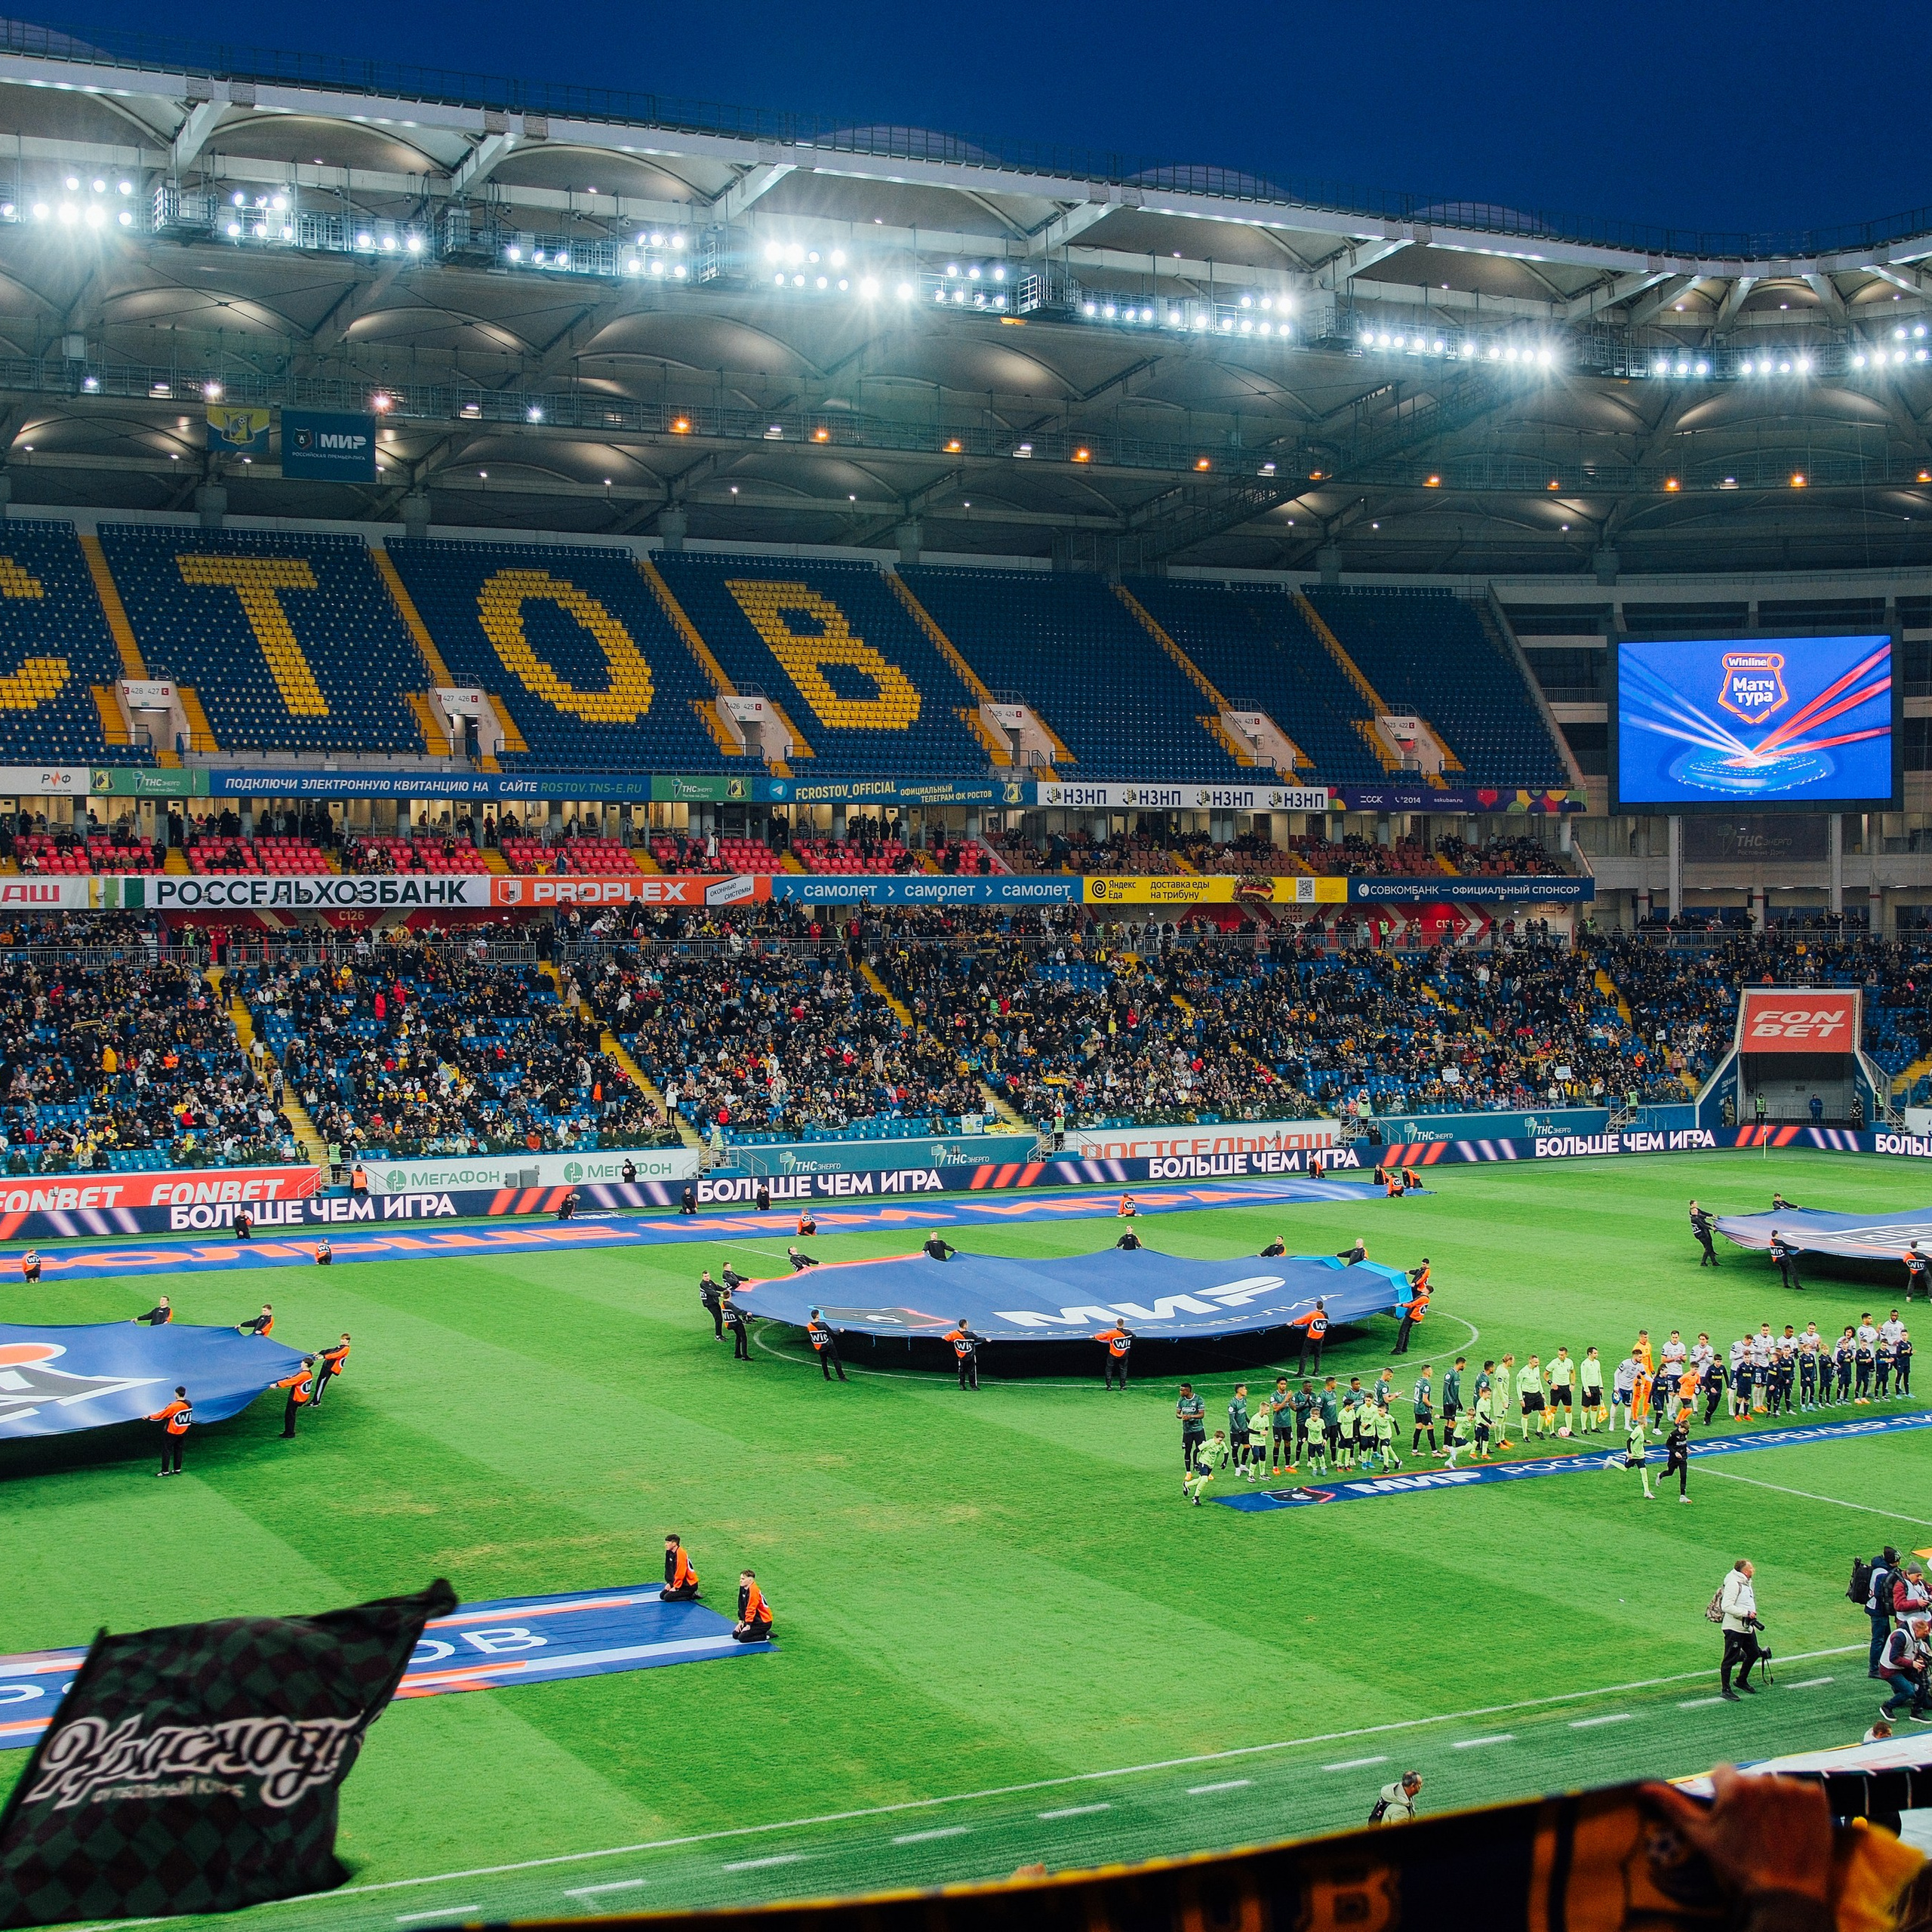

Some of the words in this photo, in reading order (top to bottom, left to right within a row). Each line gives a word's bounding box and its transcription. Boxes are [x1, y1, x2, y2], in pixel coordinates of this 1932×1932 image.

[321, 433, 367, 450] МИР
[1727, 657, 1767, 666] Winline
[1733, 677, 1775, 692] Матч
[1735, 691, 1774, 706] тура
[145, 778, 162, 786] ТНС
[226, 778, 297, 789] ПОДКЛЮЧИ
[300, 779, 390, 791] ЭЛЕКТРОННУЮ
[393, 780, 469, 792] КВИТАНЦИЮ
[472, 782, 489, 792] НА
[499, 780, 537, 792] САЙТЕ
[540, 783, 642, 793] ROSTOV.TNS-E.RU
[682, 785, 697, 793] ТНС
[795, 781, 897, 800] FCROSTOV_OFFICIAL
[900, 784, 953, 796] ОФИЦИАЛЬНЫЙ
[921, 794, 955, 803] ТЕЛЕГРАМ
[967, 790, 992, 800] РОСТОВ
[1064, 789, 1106, 804] НЗНП
[1140, 789, 1181, 806] НЗНП
[1213, 791, 1254, 807] НЗНП
[1284, 792, 1324, 808] НЗНП
[1737, 835, 1763, 847] ТНС
[157, 880, 468, 905] РОССЕЛЬХОЗБАНК
[534, 882, 686, 902] PROPLEX
[724, 885, 752, 900] системы
[804, 884, 878, 897] самолет
[905, 884, 976, 897] самолет
[1002, 884, 1071, 897] самолет
[1109, 880, 1137, 890] Яндекс
[1150, 881, 1191, 890] доставка
[1194, 881, 1210, 890] еды
[1370, 885, 1439, 895] СОВКОМБАНК
[1452, 884, 1530, 895] ОФИЦИАЛЬНЫЙ
[1532, 885, 1580, 895] СПОНСОР
[2, 884, 60, 902] АШ
[1109, 891, 1123, 900] Еда
[1163, 891, 1199, 900] трибуну
[339, 910, 365, 921] C126
[1752, 1010, 1846, 1024] FON
[1751, 1023, 1845, 1038] BET
[1417, 1131, 1435, 1141] ТНС
[1537, 1124, 1554, 1134] ТНС
[1535, 1134, 1622, 1157] БОЛЬШЕ
[1623, 1133, 1666, 1151] ЧЕМ
[1669, 1130, 1717, 1149] ИГРА
[795, 1161, 817, 1173] ТНС
[817, 1162, 841, 1171] ЭНЕРГО
[946, 1154, 967, 1165] ТНС
[968, 1155, 989, 1164] ЭНЕРГО
[1149, 1153, 1247, 1179] БОЛЬШЕ
[1251, 1150, 1300, 1173] ЧЕМ
[1306, 1148, 1360, 1169] ИГРА
[817, 1172, 873, 1195] ЧЕМ
[881, 1169, 944, 1192] ИГРА
[0, 1186, 123, 1212] ONBET
[150, 1179, 285, 1205] FONBET
[310, 1195, 375, 1222] ЧЕМ
[383, 1192, 457, 1220] ИГРА
[992, 1275, 1286, 1327] МИР
[1345, 1471, 1481, 1494] МИР
